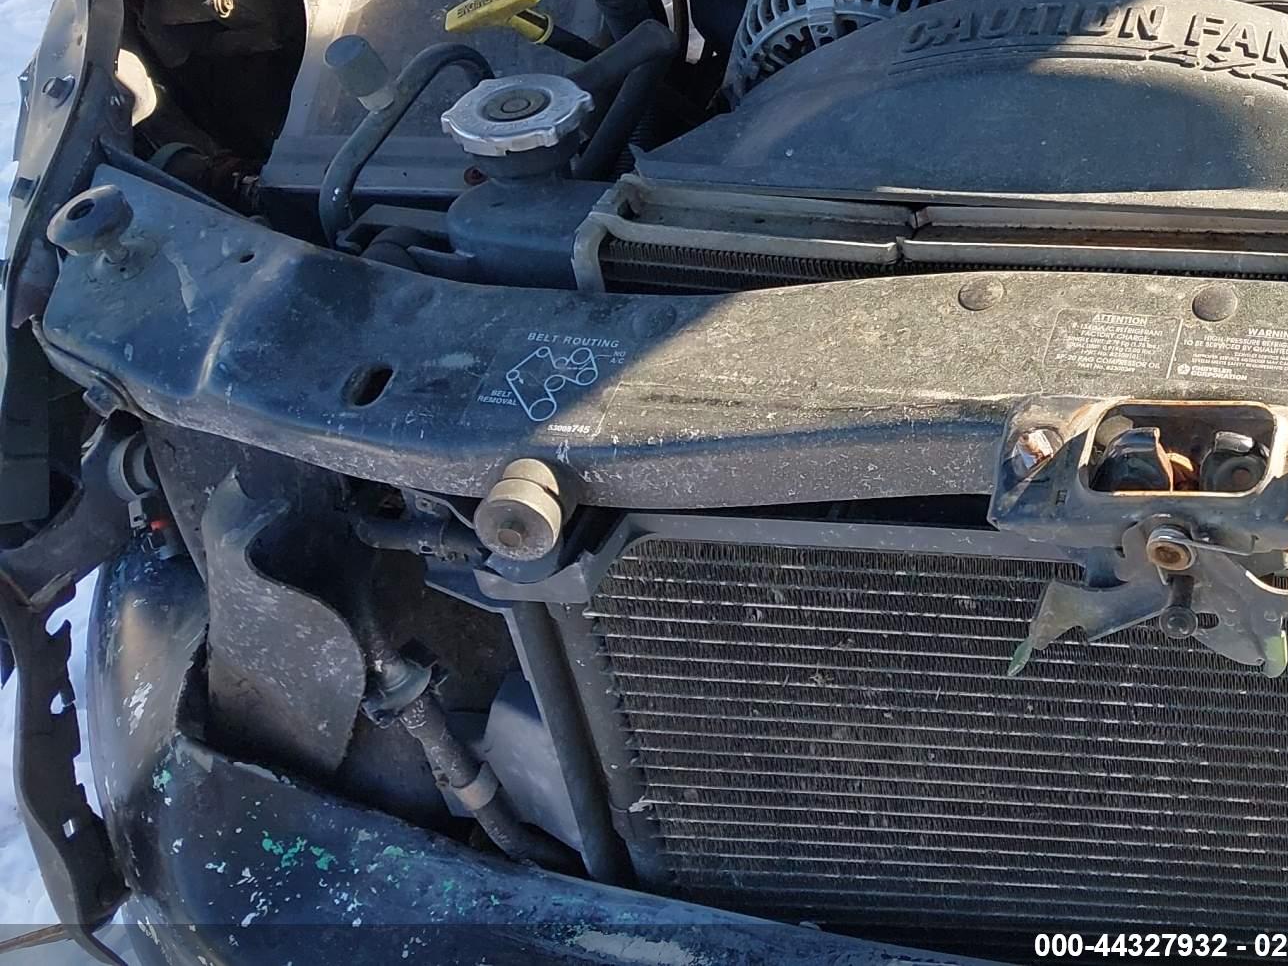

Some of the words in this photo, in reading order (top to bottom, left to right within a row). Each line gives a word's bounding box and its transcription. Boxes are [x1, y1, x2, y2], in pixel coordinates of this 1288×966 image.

[902, 4, 1166, 53] CAUTION
[1092, 314, 1148, 326] ATTENTION
[528, 332, 558, 343] BELT
[563, 336, 620, 348] ROUTING
[1080, 331, 1114, 339] FACTORY
[1205, 342, 1240, 350] SERVICED
[1096, 357, 1146, 368] COMPRESSOR
[1190, 370, 1248, 380] CORPORATION
[490, 389, 512, 398] BELT
[477, 395, 518, 406] REMOVAL
